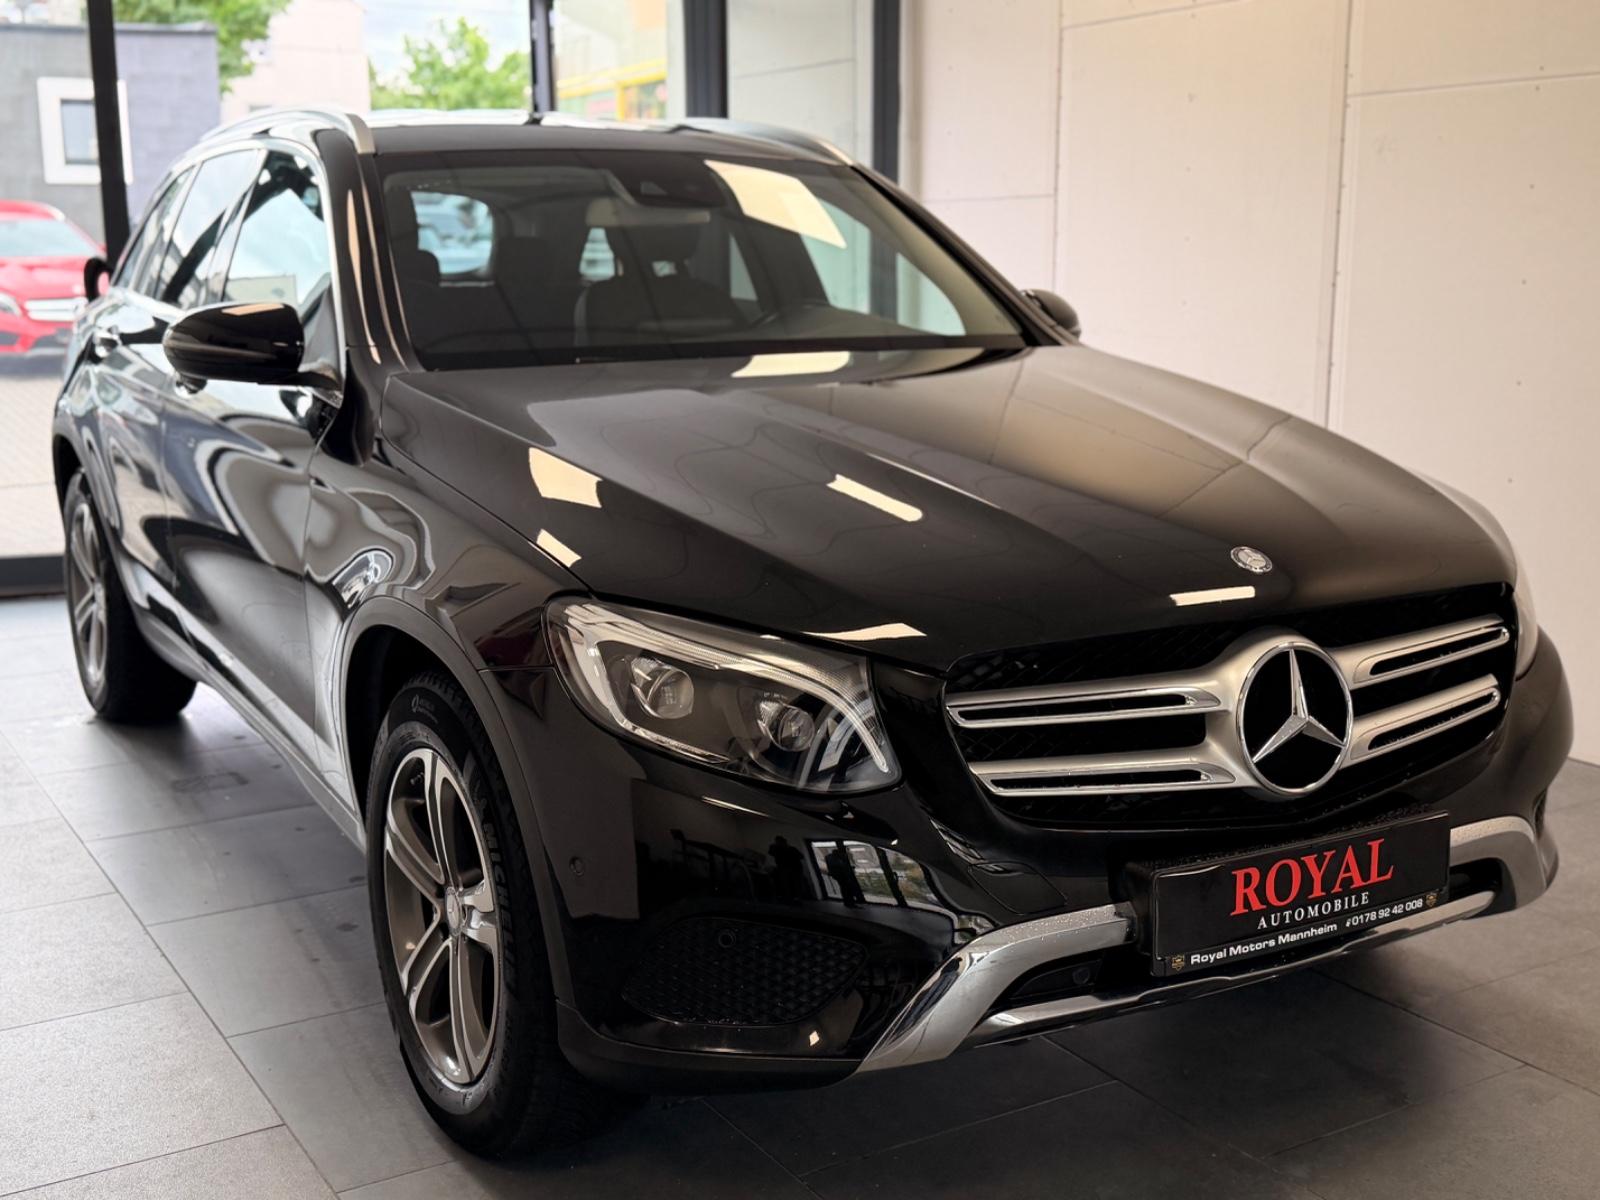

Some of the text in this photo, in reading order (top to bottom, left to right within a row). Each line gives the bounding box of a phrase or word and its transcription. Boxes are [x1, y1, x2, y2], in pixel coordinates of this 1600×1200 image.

[1230, 838, 1394, 916] ROYAL
[1257, 891, 1370, 930] AUTOMOBILE
[1190, 898, 1424, 965] Royal Motors Mannheim 0178 92 42 008
